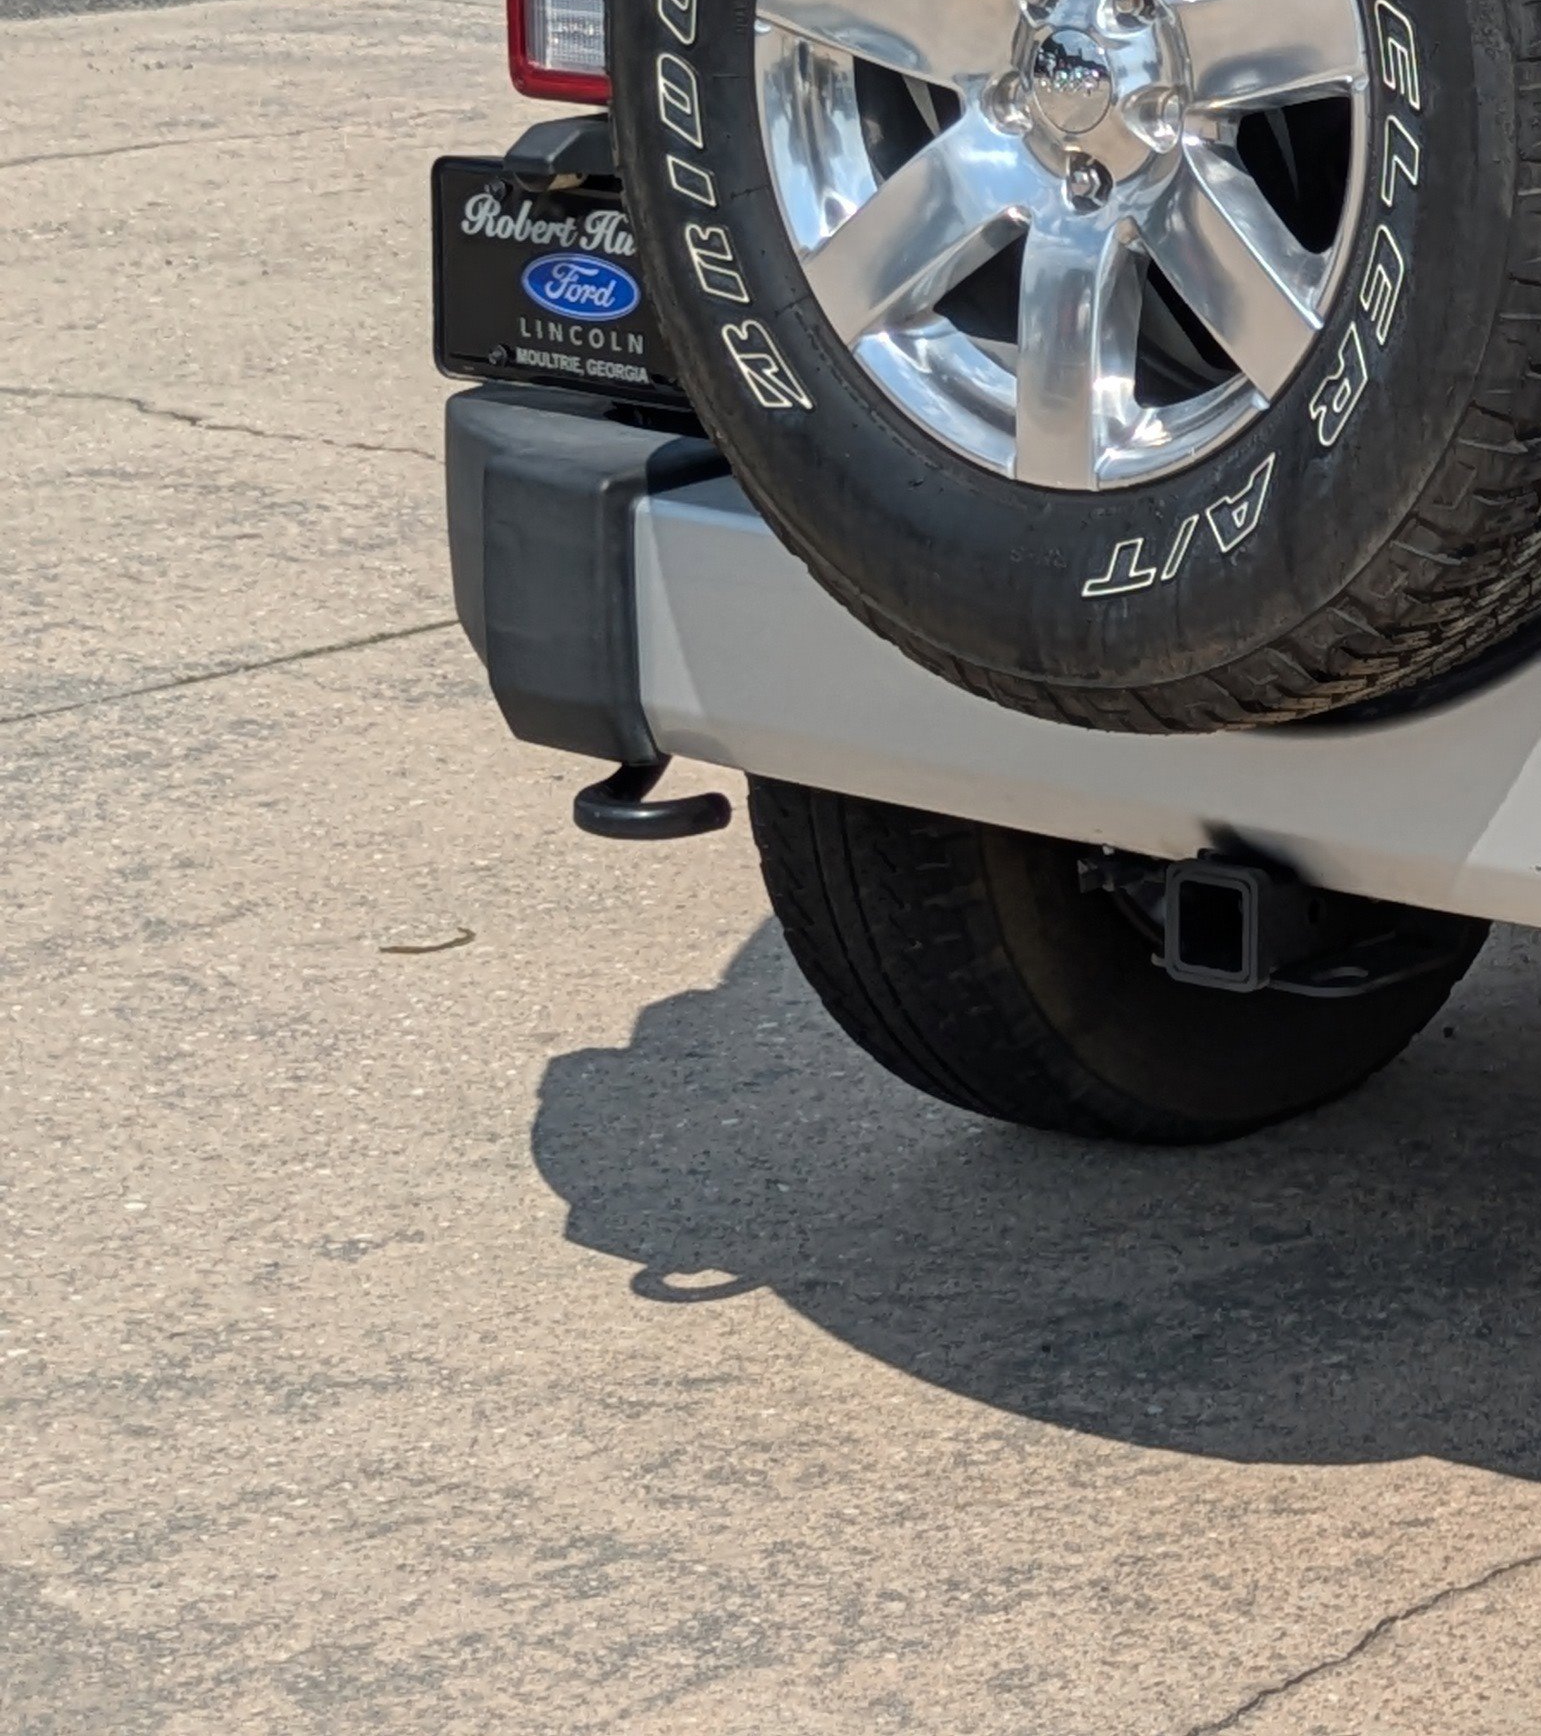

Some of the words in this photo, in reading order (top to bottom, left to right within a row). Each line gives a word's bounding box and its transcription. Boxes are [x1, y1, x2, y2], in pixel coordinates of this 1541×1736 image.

[461, 193, 579, 247] Robert
[579, 209, 637, 257] Hu
[543, 262, 617, 308] Ford
[518, 316, 645, 355] LINCOLN
[515, 347, 585, 377] MOULTRIE,
[585, 358, 650, 385] GEORGIA
[1080, 454, 1276, 598] A/T
